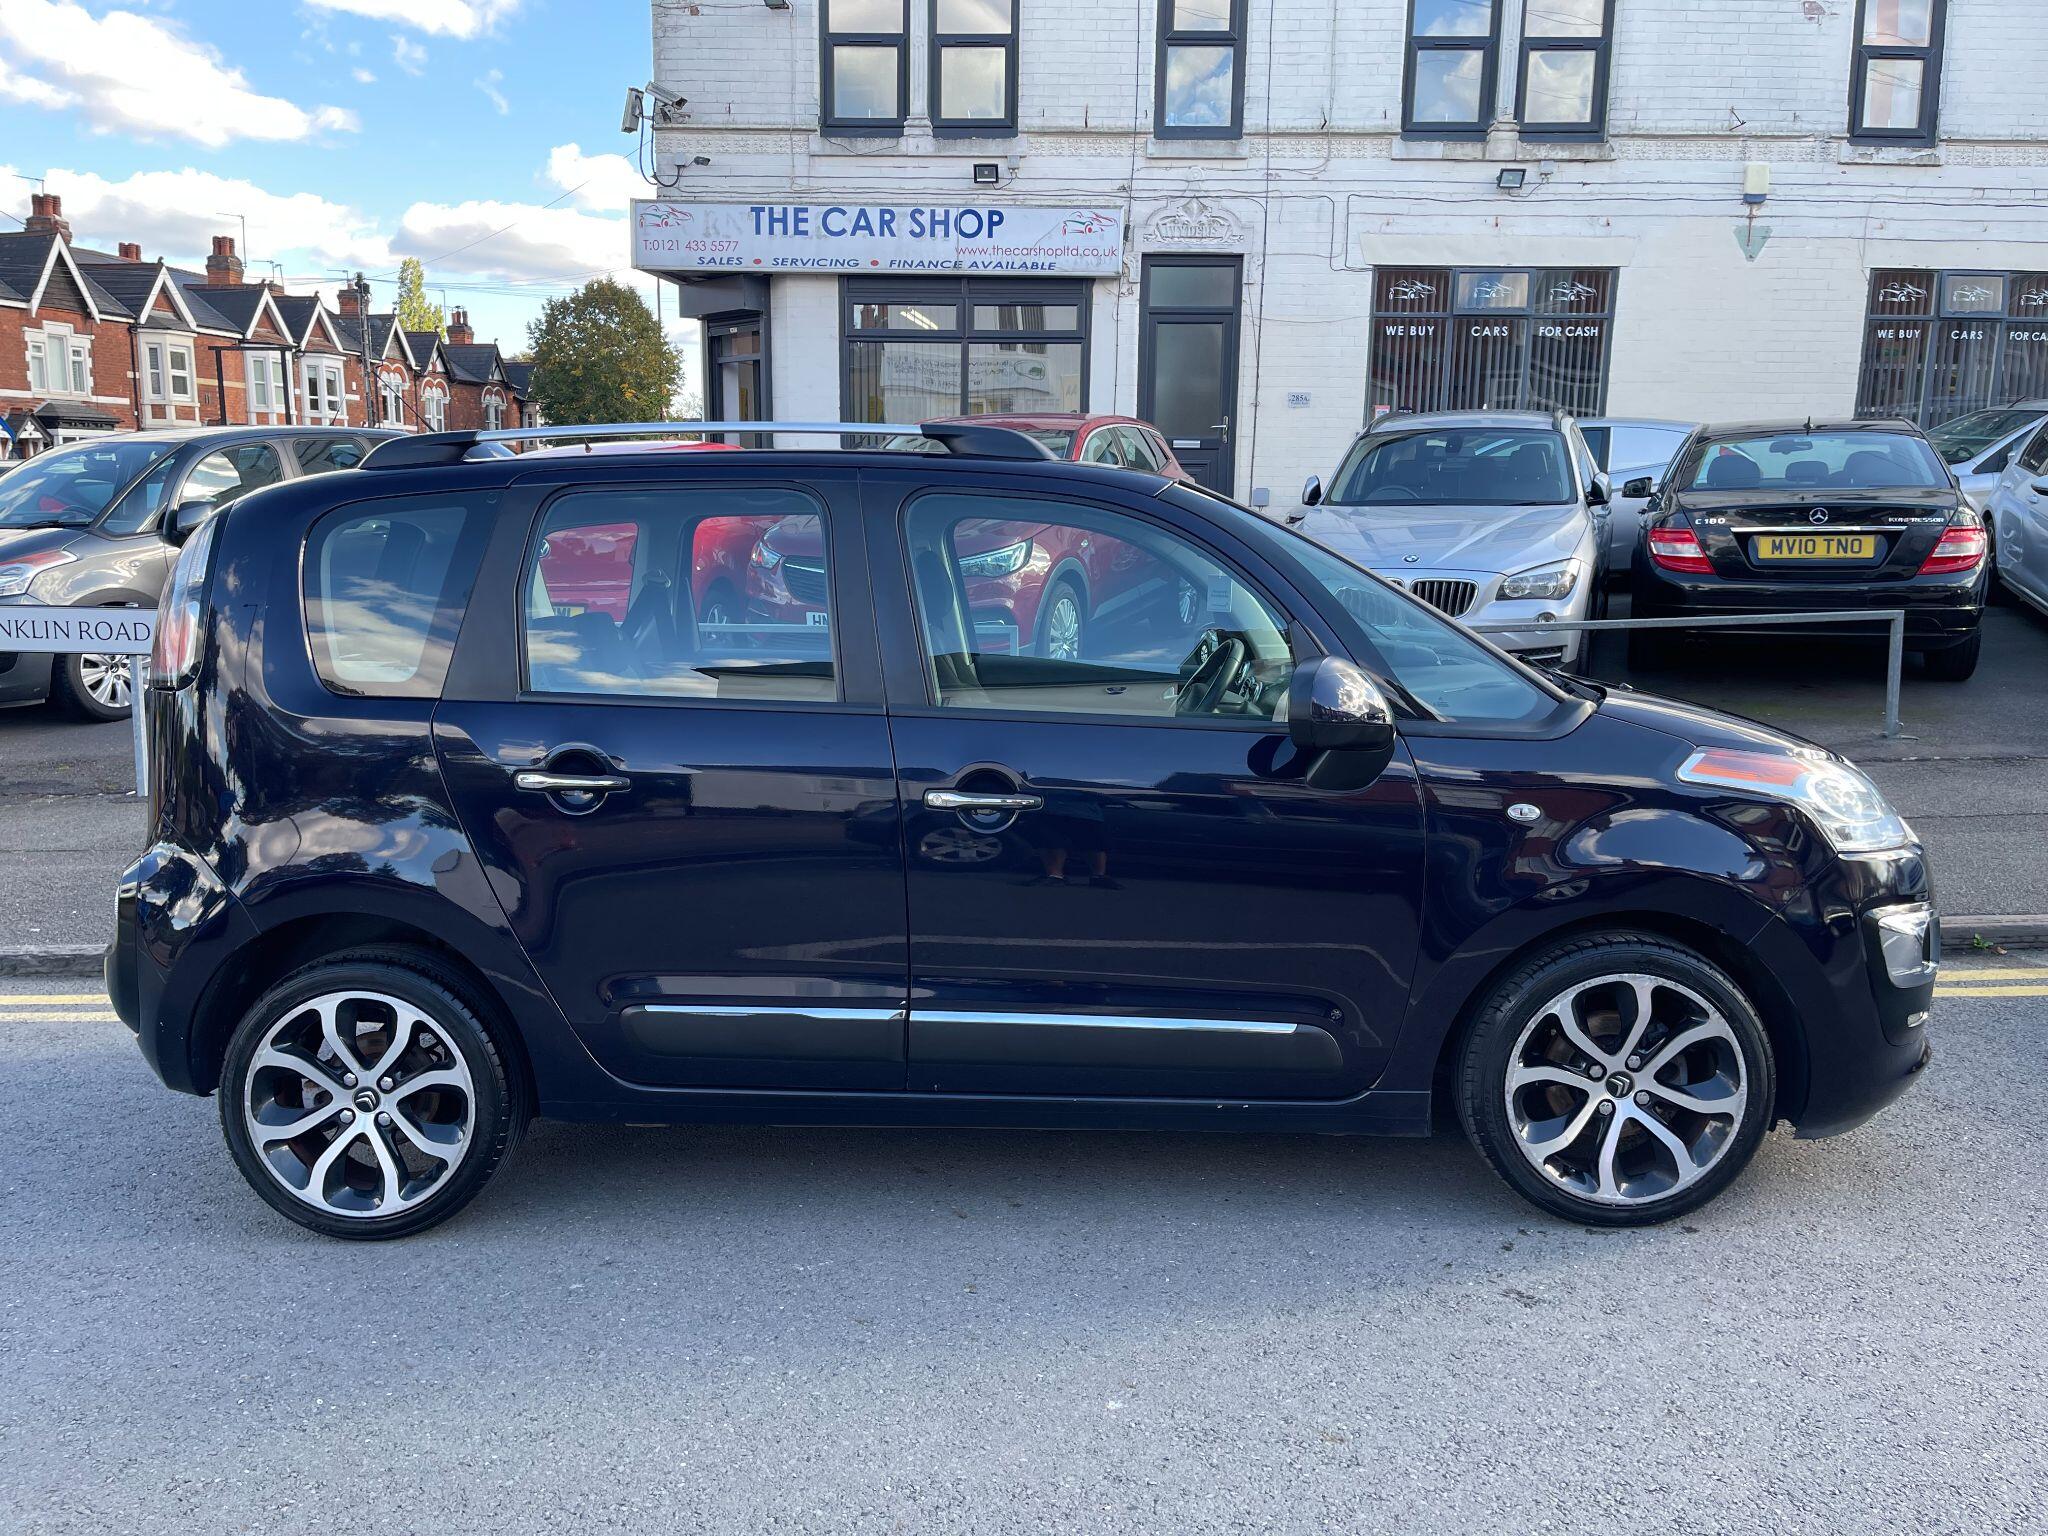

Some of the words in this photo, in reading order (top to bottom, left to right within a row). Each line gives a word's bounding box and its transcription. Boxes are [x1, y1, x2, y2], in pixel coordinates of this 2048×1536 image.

[750, 206, 809, 236] THE
[821, 207, 896, 238] CAR
[908, 208, 1005, 239] SHOP
[643, 240, 680, 251] T:0121
[685, 240, 707, 252] 433
[710, 241, 739, 252] 5577
[955, 245, 1118, 260] www.thecarshopltd.co.uk
[697, 256, 743, 266] SALES
[771, 257, 860, 268] SERVICING
[889, 259, 963, 269] FINANCE
[968, 261, 1057, 271] AVAILABLE
[1385, 325, 1404, 336] WE
[1410, 325, 1435, 336] BUY
[1471, 326, 1509, 337] CARS
[1539, 326, 1562, 337] FOR
[1565, 326, 1599, 337] CASH
[1877, 329, 1894, 339] WE
[1898, 329, 1921, 339] BUY
[1951, 330, 1984, 340] CARS
[2010, 331, 2029, 341] FOR
[2031, 332, 2048, 341] CA
[1704, 517, 1726, 525] 180
[1771, 538, 1816, 555] MV10
[1823, 538, 1862, 555] TNO
[78, 621, 151, 641] ROAD
